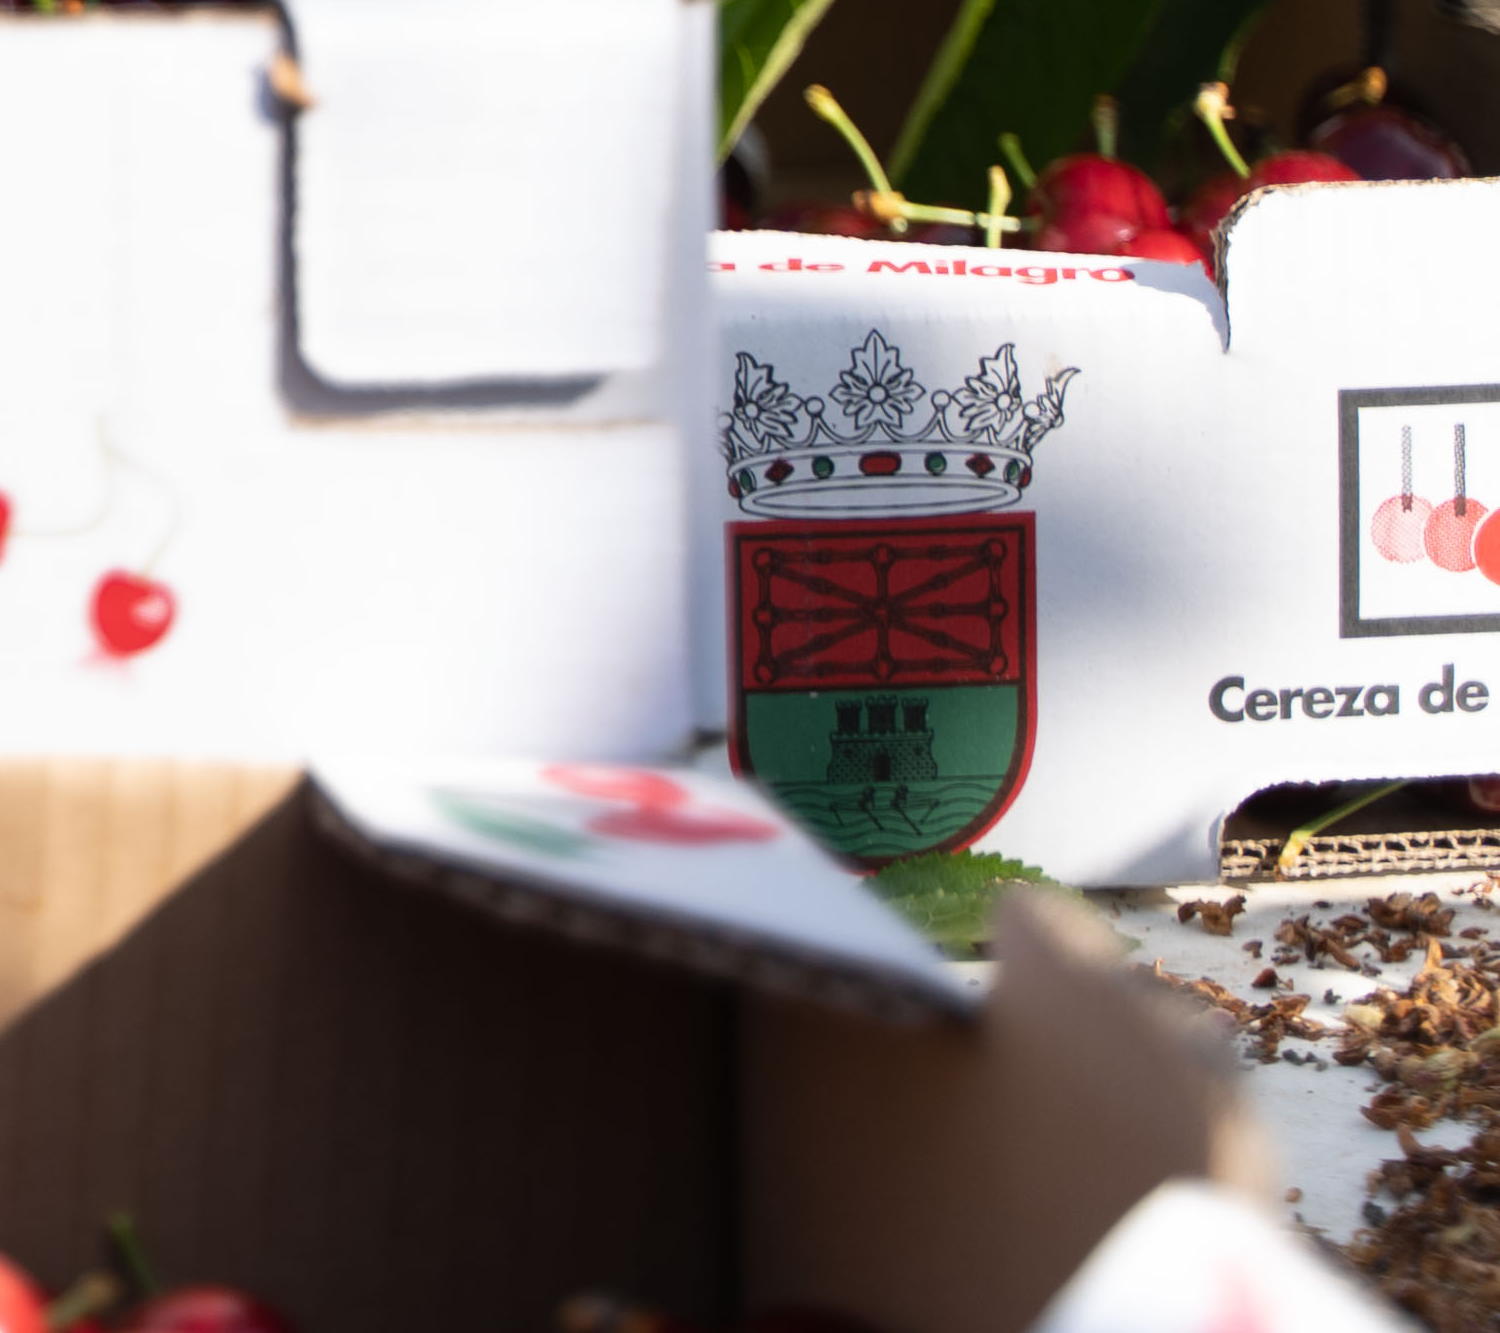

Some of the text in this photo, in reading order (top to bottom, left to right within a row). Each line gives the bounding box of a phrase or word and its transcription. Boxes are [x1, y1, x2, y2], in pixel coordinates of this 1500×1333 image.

[758, 258, 843, 272] de
[866, 259, 1136, 286] Milagro
[1208, 662, 1490, 723] Cereza de
